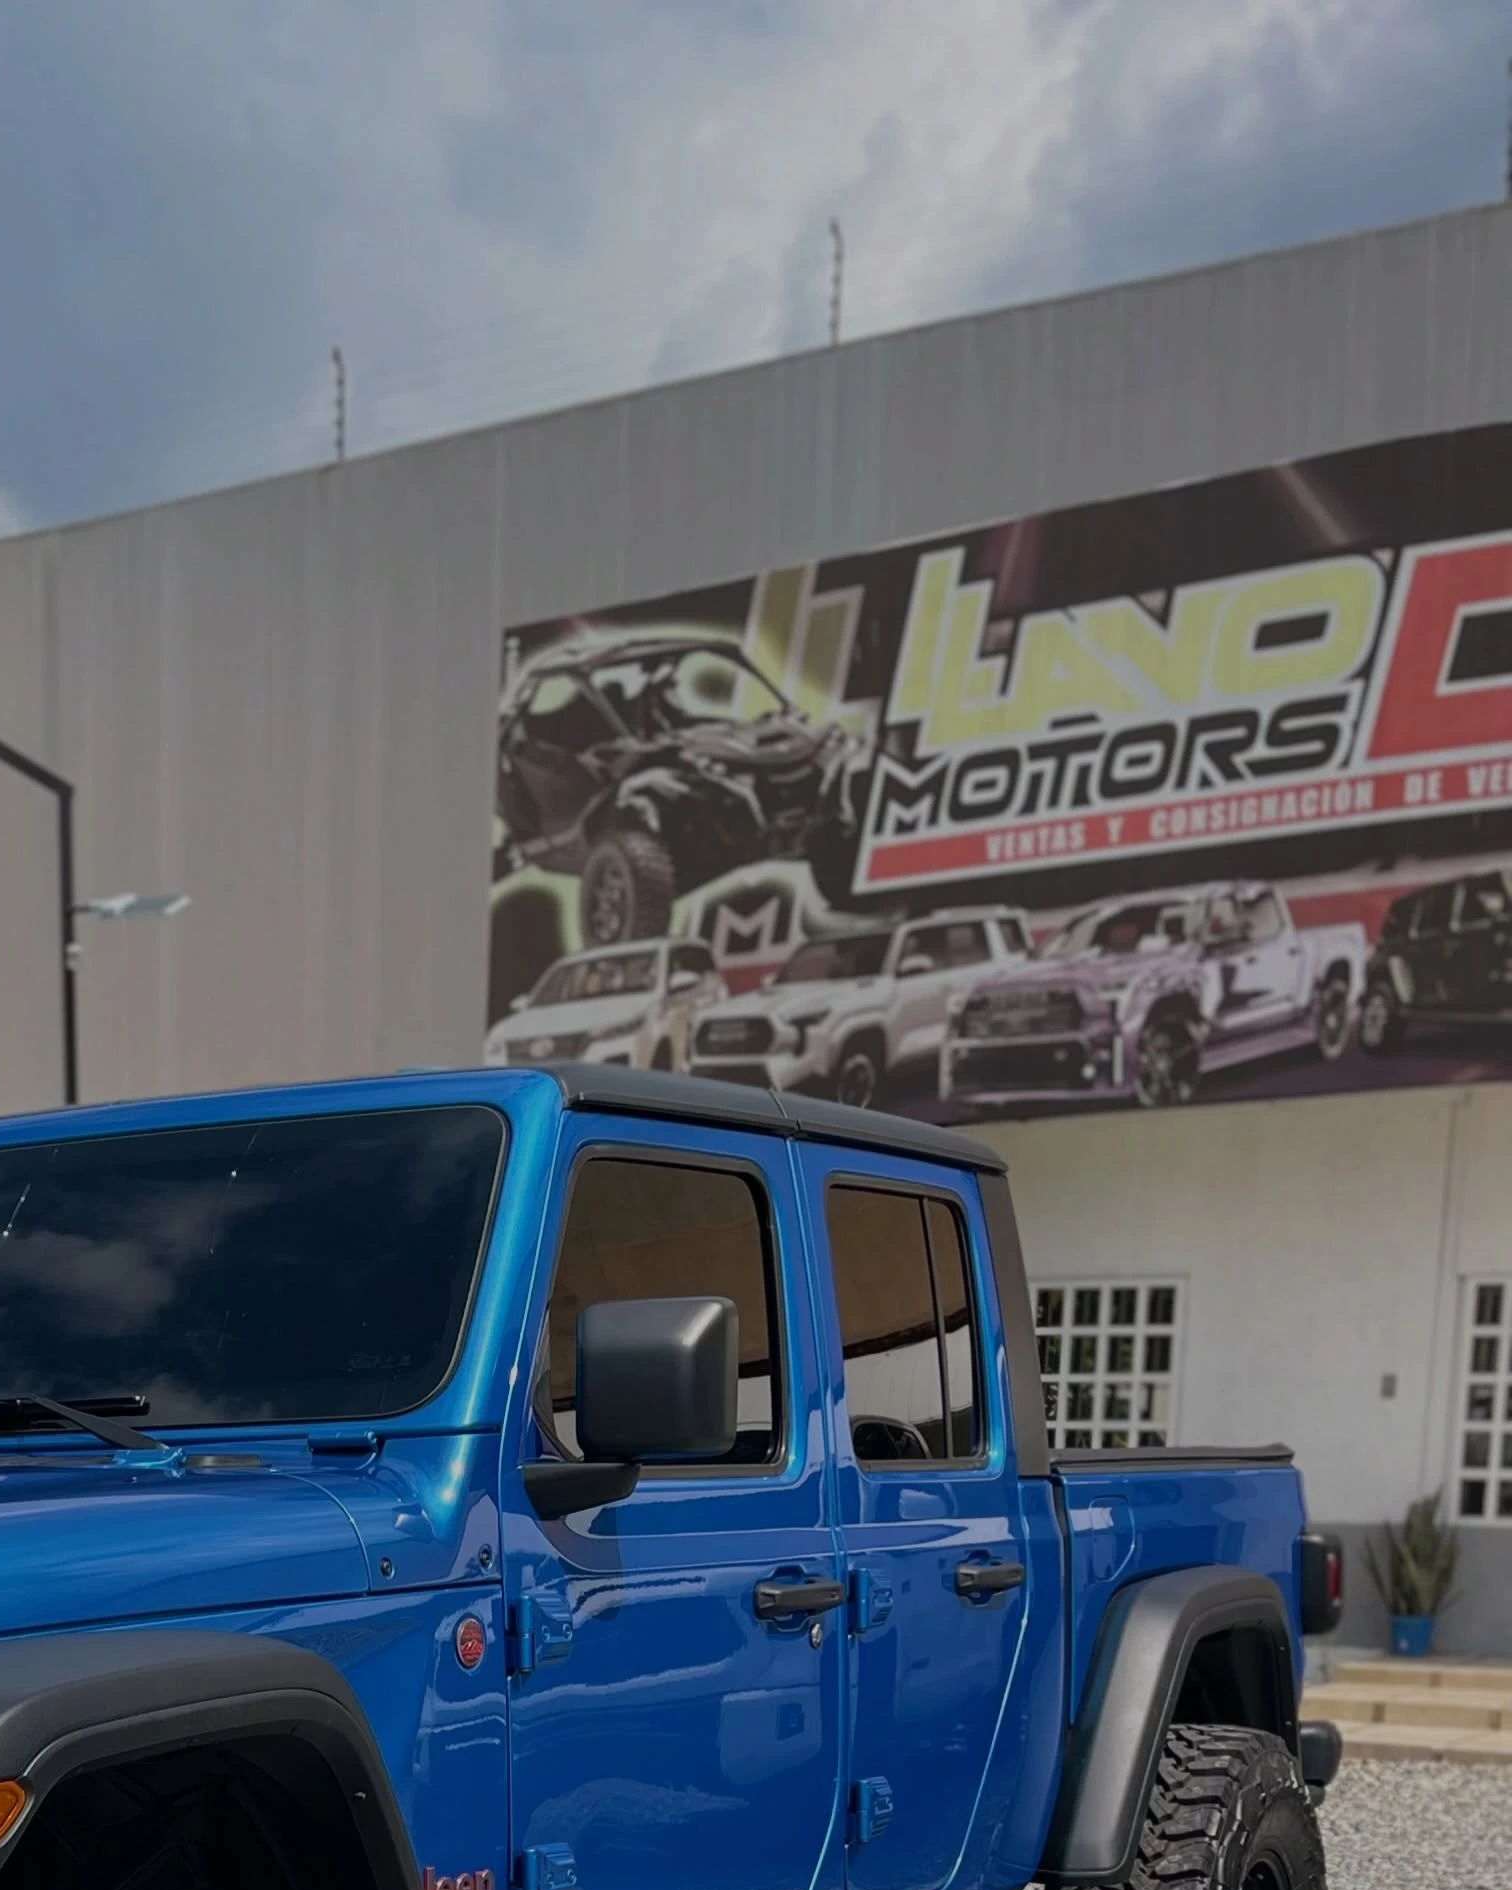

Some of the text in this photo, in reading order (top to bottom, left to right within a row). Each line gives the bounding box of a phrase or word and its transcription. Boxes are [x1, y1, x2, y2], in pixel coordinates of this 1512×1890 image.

[874, 693, 1351, 837] MOTORS
[985, 821, 1085, 862] VENTAS
[1106, 816, 1124, 844] Y
[1403, 770, 1444, 804] DE
[1466, 762, 1512, 798] VE
